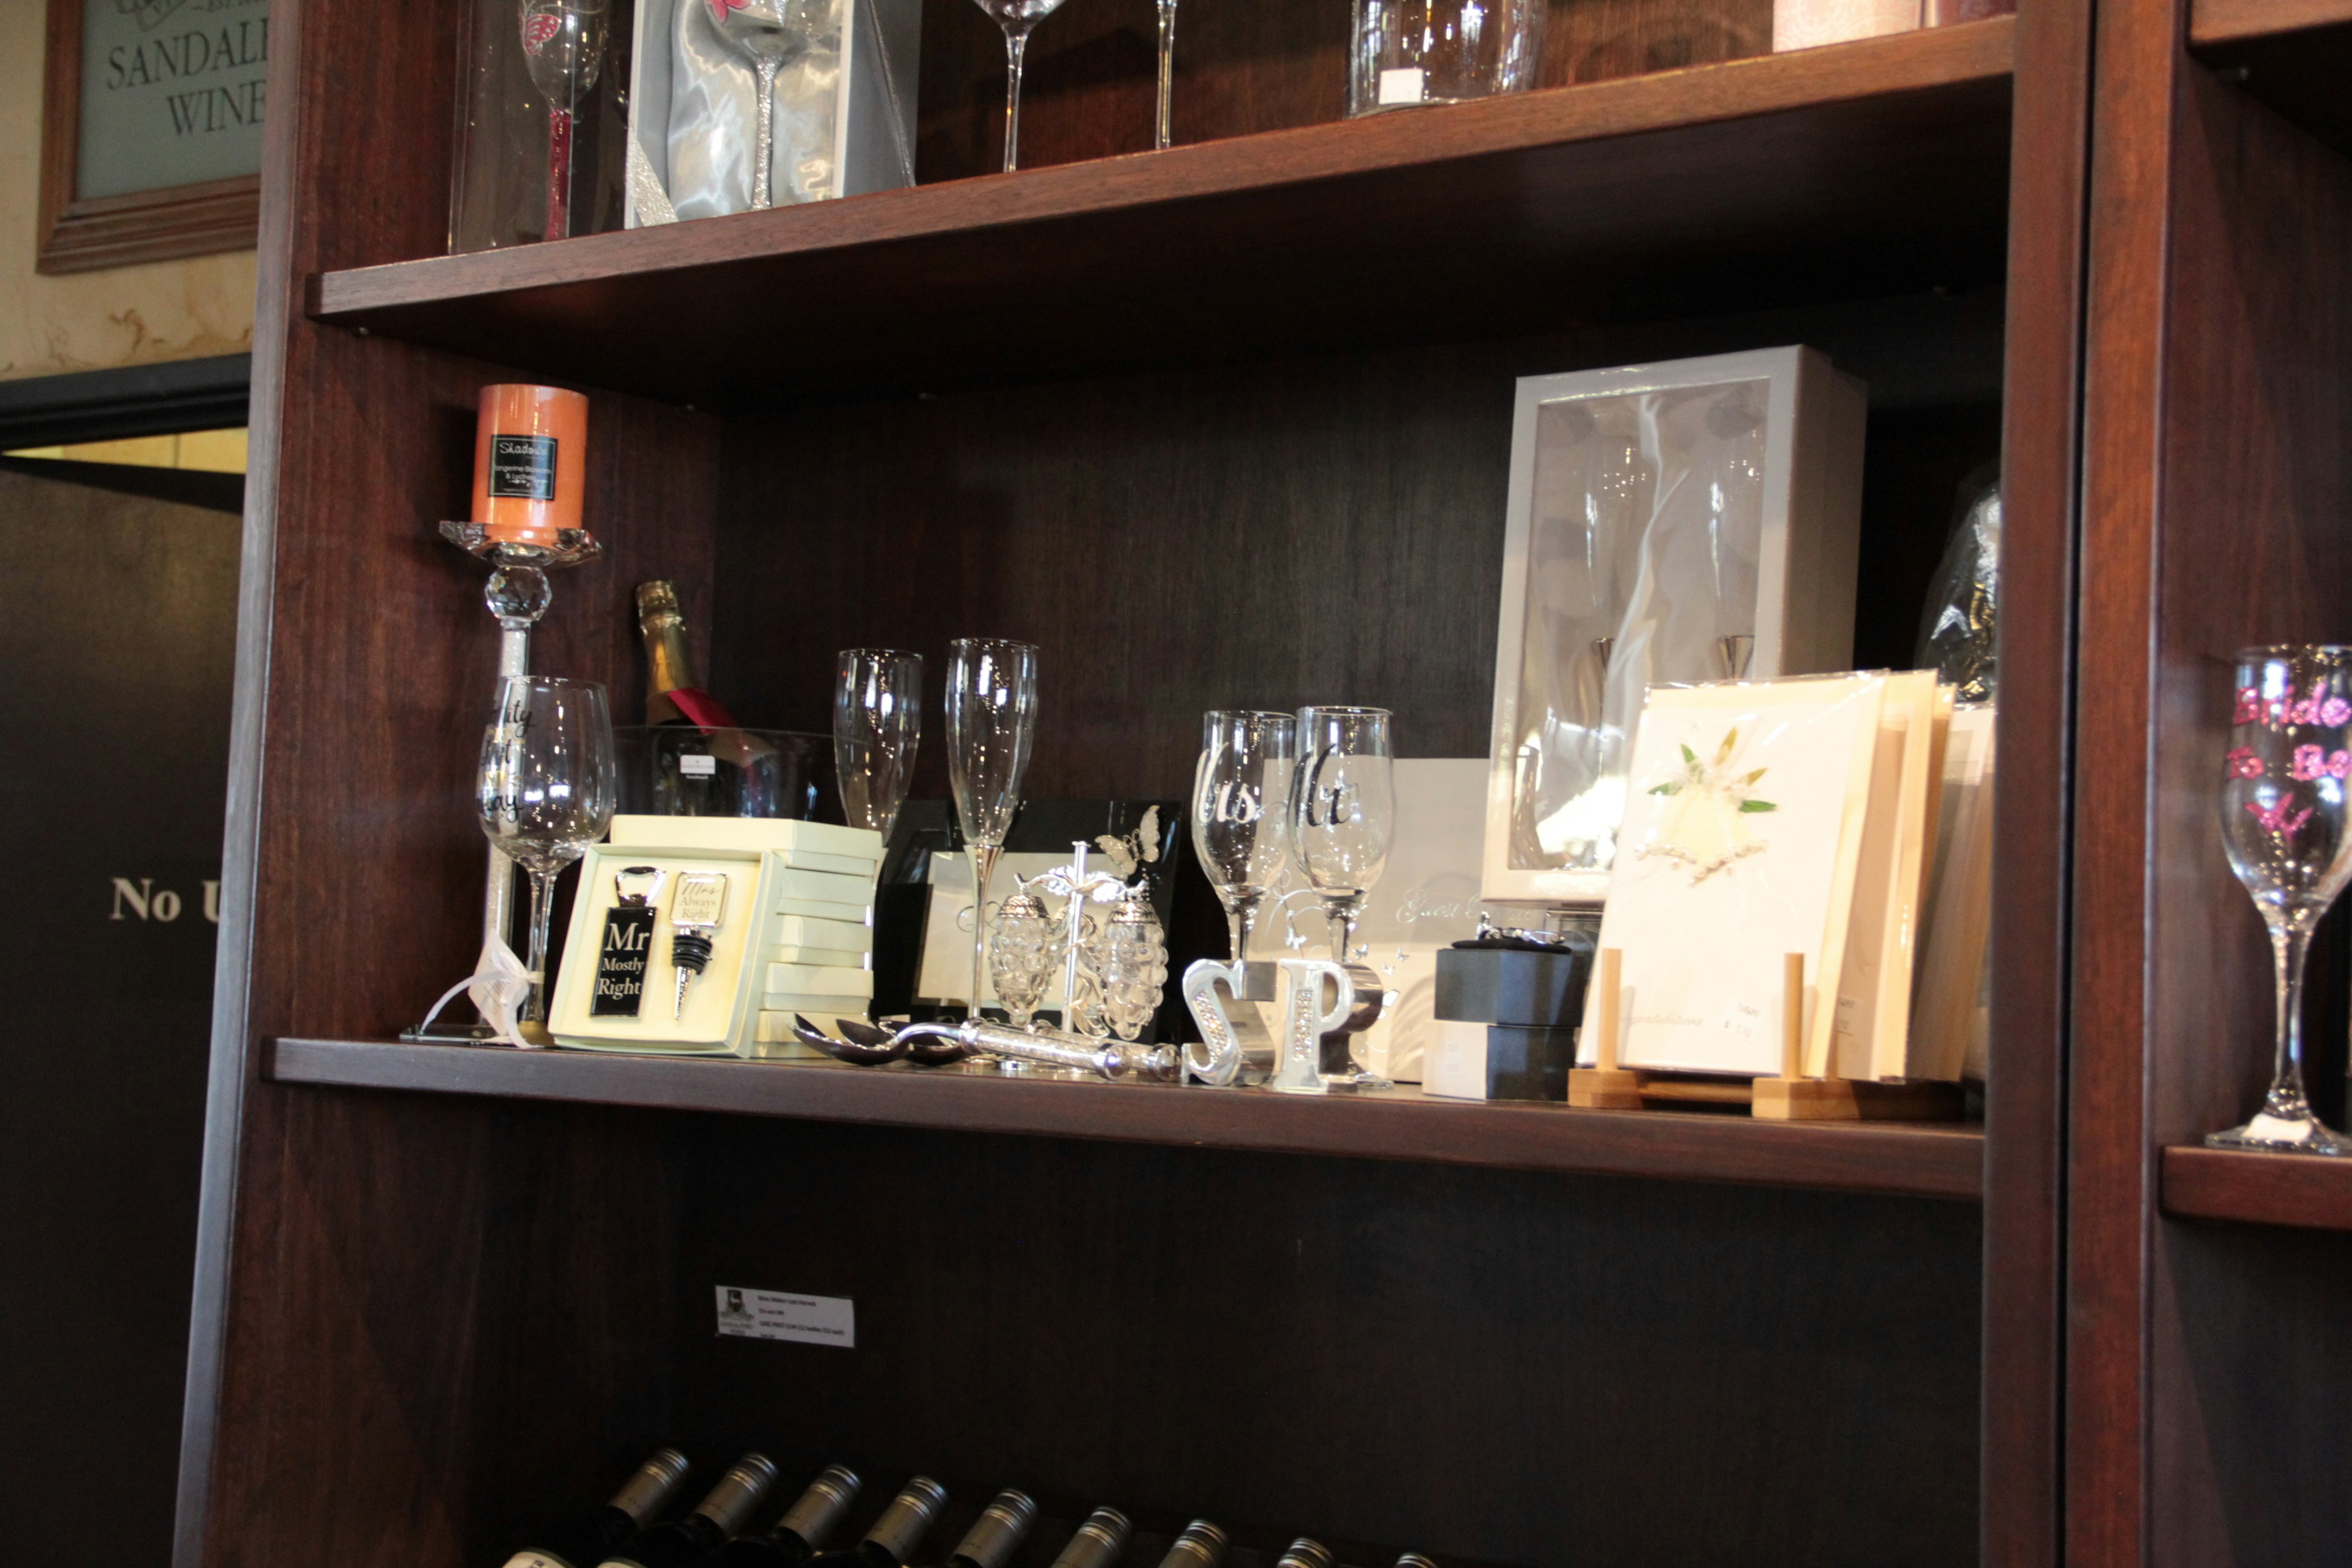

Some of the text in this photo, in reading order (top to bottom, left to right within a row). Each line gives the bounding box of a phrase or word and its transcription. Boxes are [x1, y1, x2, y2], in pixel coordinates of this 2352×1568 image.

[109, 878, 181, 922] No
[679, 897, 716, 909] Always
[682, 908, 709, 921] Right
[605, 922, 650, 951] Mr
[601, 957, 644, 974] Mostly
[597, 978, 641, 1000] Right
